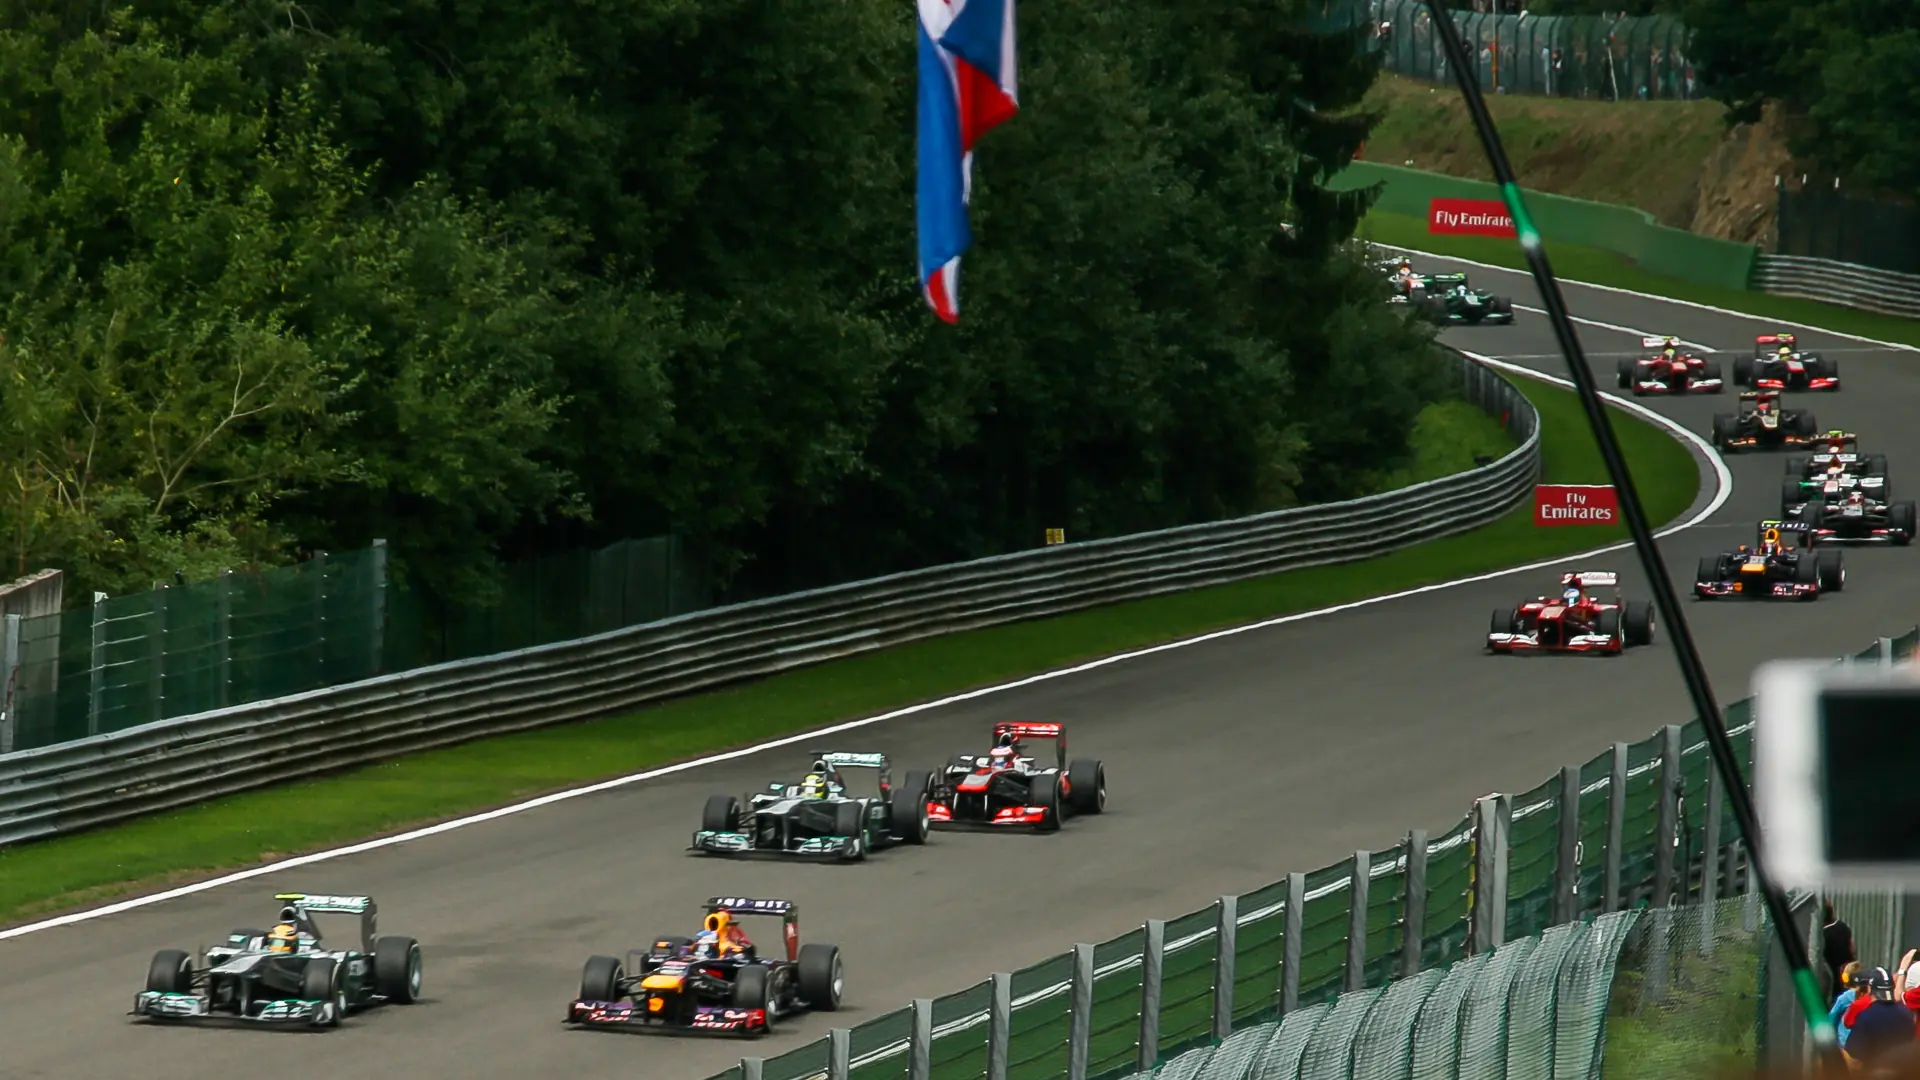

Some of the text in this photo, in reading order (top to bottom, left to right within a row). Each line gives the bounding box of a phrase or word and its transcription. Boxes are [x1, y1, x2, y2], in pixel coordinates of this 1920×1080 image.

[1435, 210, 1515, 228] Fly Emirate
[1566, 492, 1586, 504] Fly
[1541, 504, 1612, 519] Emirates
